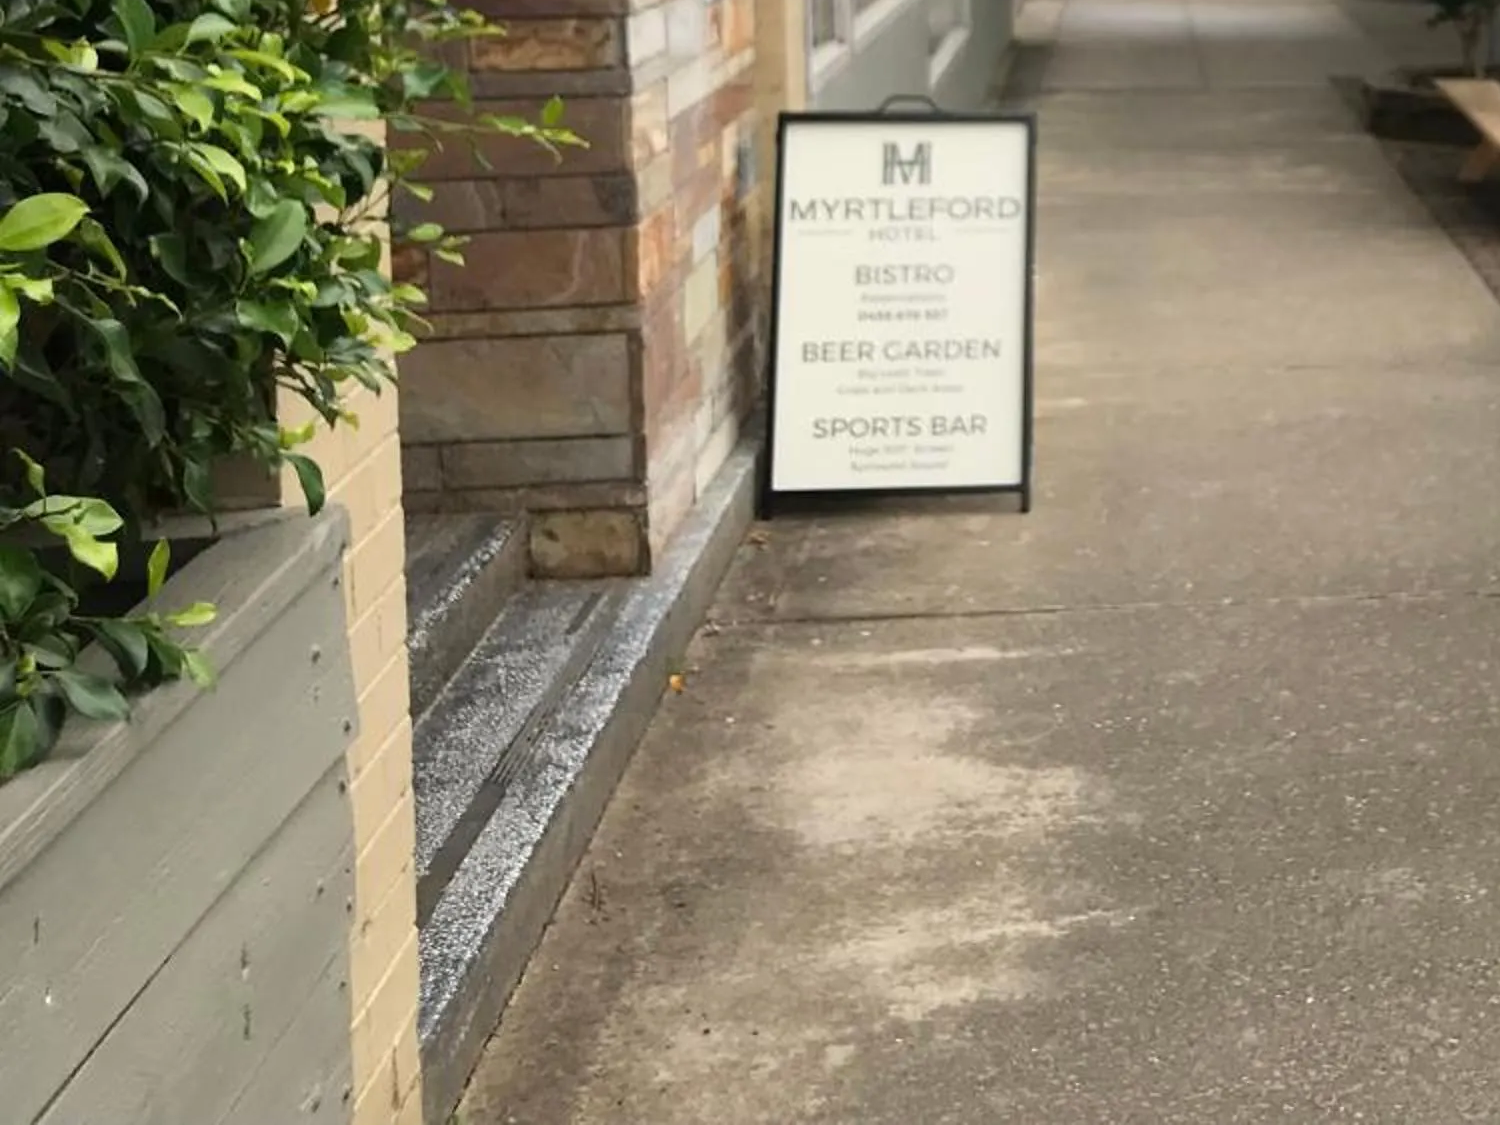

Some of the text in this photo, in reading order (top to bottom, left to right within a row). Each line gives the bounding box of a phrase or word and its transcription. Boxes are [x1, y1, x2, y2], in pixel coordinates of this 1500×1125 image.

[789, 196, 1022, 222] MYRTLEFORD
[867, 225, 940, 243] HOTEL
[854, 263, 955, 286] BISTRO
[801, 338, 1001, 364] BEER GARDEN
[812, 414, 987, 440] SPORTS BAR
